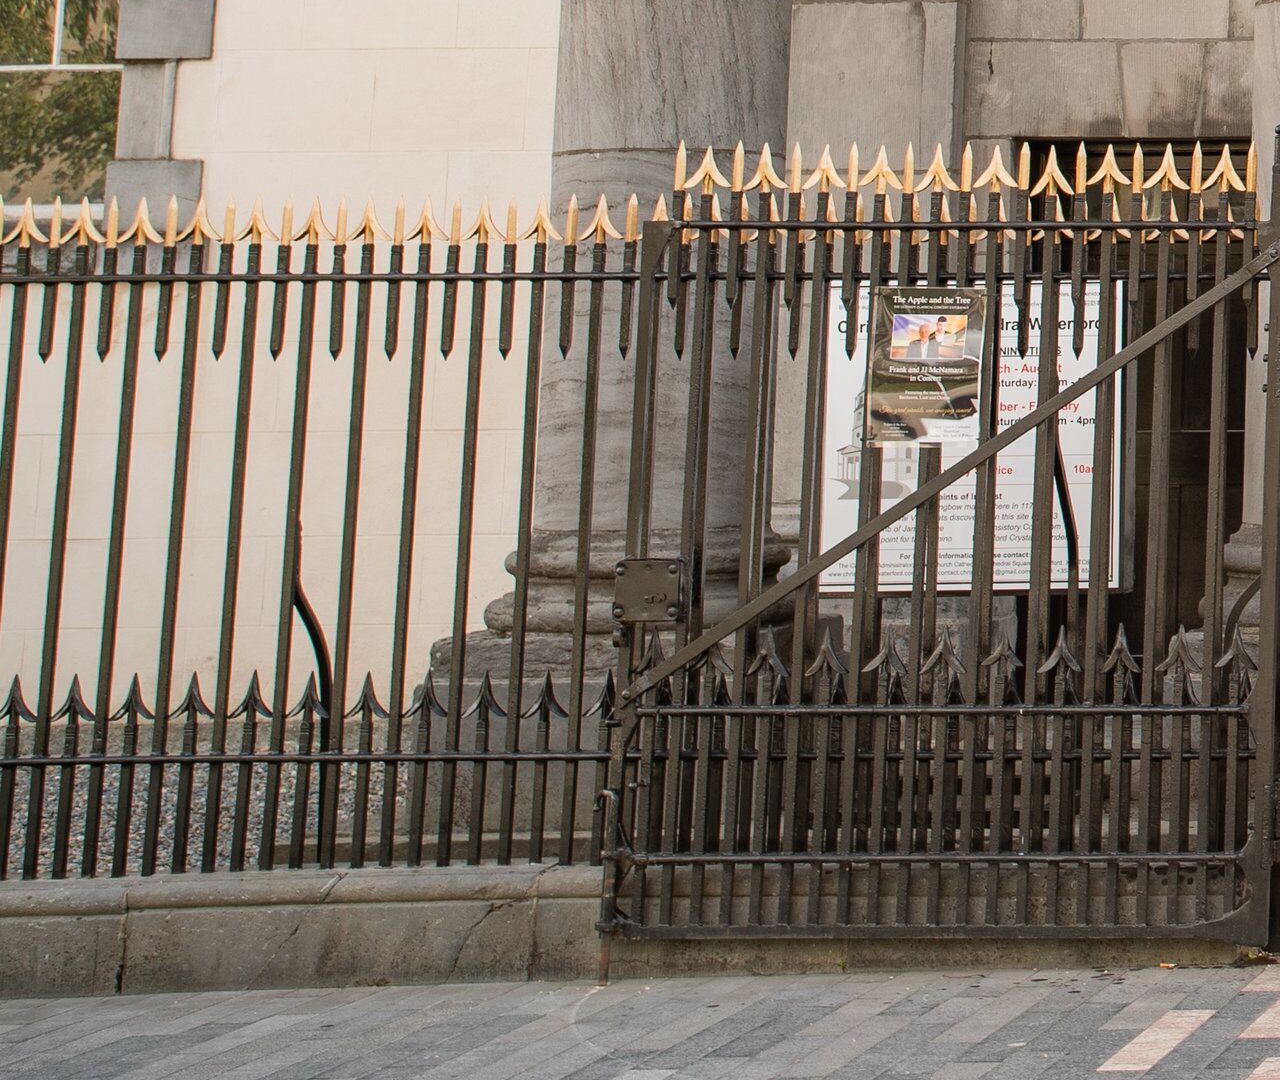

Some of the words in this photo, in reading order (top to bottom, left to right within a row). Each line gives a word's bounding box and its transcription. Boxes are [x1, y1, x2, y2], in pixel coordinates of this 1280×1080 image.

[892, 295, 906, 304] The
[907, 295, 928, 305] Apple
[929, 296, 942, 304] and
[943, 296, 954, 304] the
[955, 296, 971, 304] Tree
[928, 366, 964, 374] McNamara
